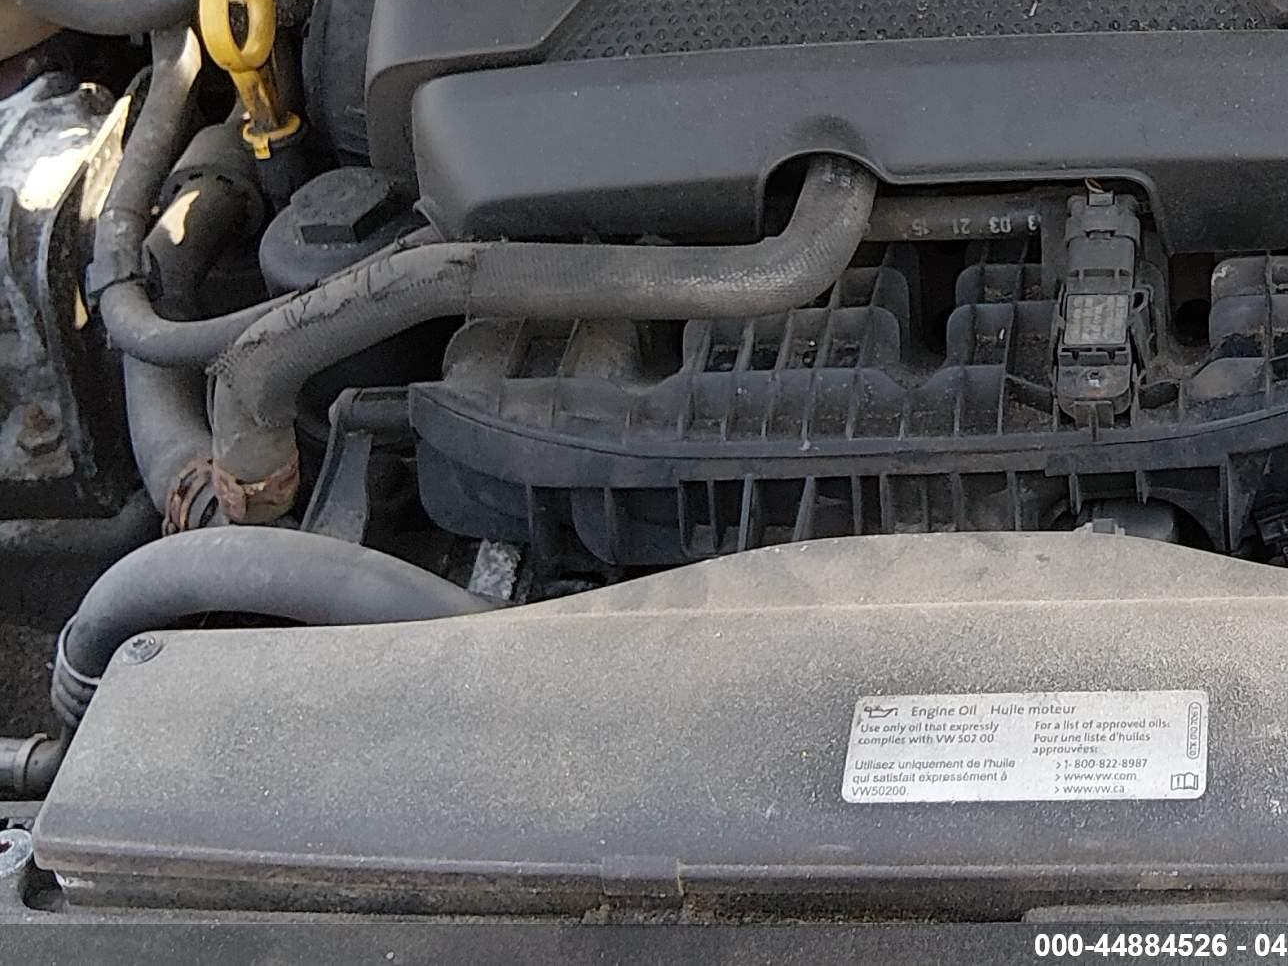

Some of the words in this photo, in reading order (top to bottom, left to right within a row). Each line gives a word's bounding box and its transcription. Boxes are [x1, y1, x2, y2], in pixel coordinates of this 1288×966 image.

[911, 705, 955, 719] Engine
[958, 704, 976, 716] Oil
[990, 704, 1024, 716] Huile
[1028, 704, 1076, 715] moteur
[860, 724, 880, 733] Use
[882, 723, 906, 734] only
[908, 723, 922, 731] oil
[925, 723, 947, 731] that
[950, 721, 999, 734] expressly
[1035, 721, 1052, 730] For
[1064, 721, 1080, 730] list
[1082, 720, 1094, 729] of
[1096, 719, 1146, 731] approved
[858, 735, 905, 746] complies
[909, 734, 933, 744] with
[936, 735, 955, 743] VW
[958, 734, 977, 743] 502
[979, 734, 995, 743] 00
[1033, 734, 1058, 743] Pour
[1060, 734, 1081, 742] une
[1084, 732, 1107, 742] liste
[1109, 732, 1151, 741] d'huiles
[855, 760, 895, 771] Utilisez
[898, 760, 963, 772] uniquement
[966, 759, 980, 768] de
[983, 759, 1016, 768] l'huile
[852, 773, 870, 784] qui
[873, 772, 916, 783] satisfait
[918, 771, 997, 783] expressément
[1064, 772, 1137, 781] www.vw.com
[1063, 785, 1125, 794] www.vw.ca
